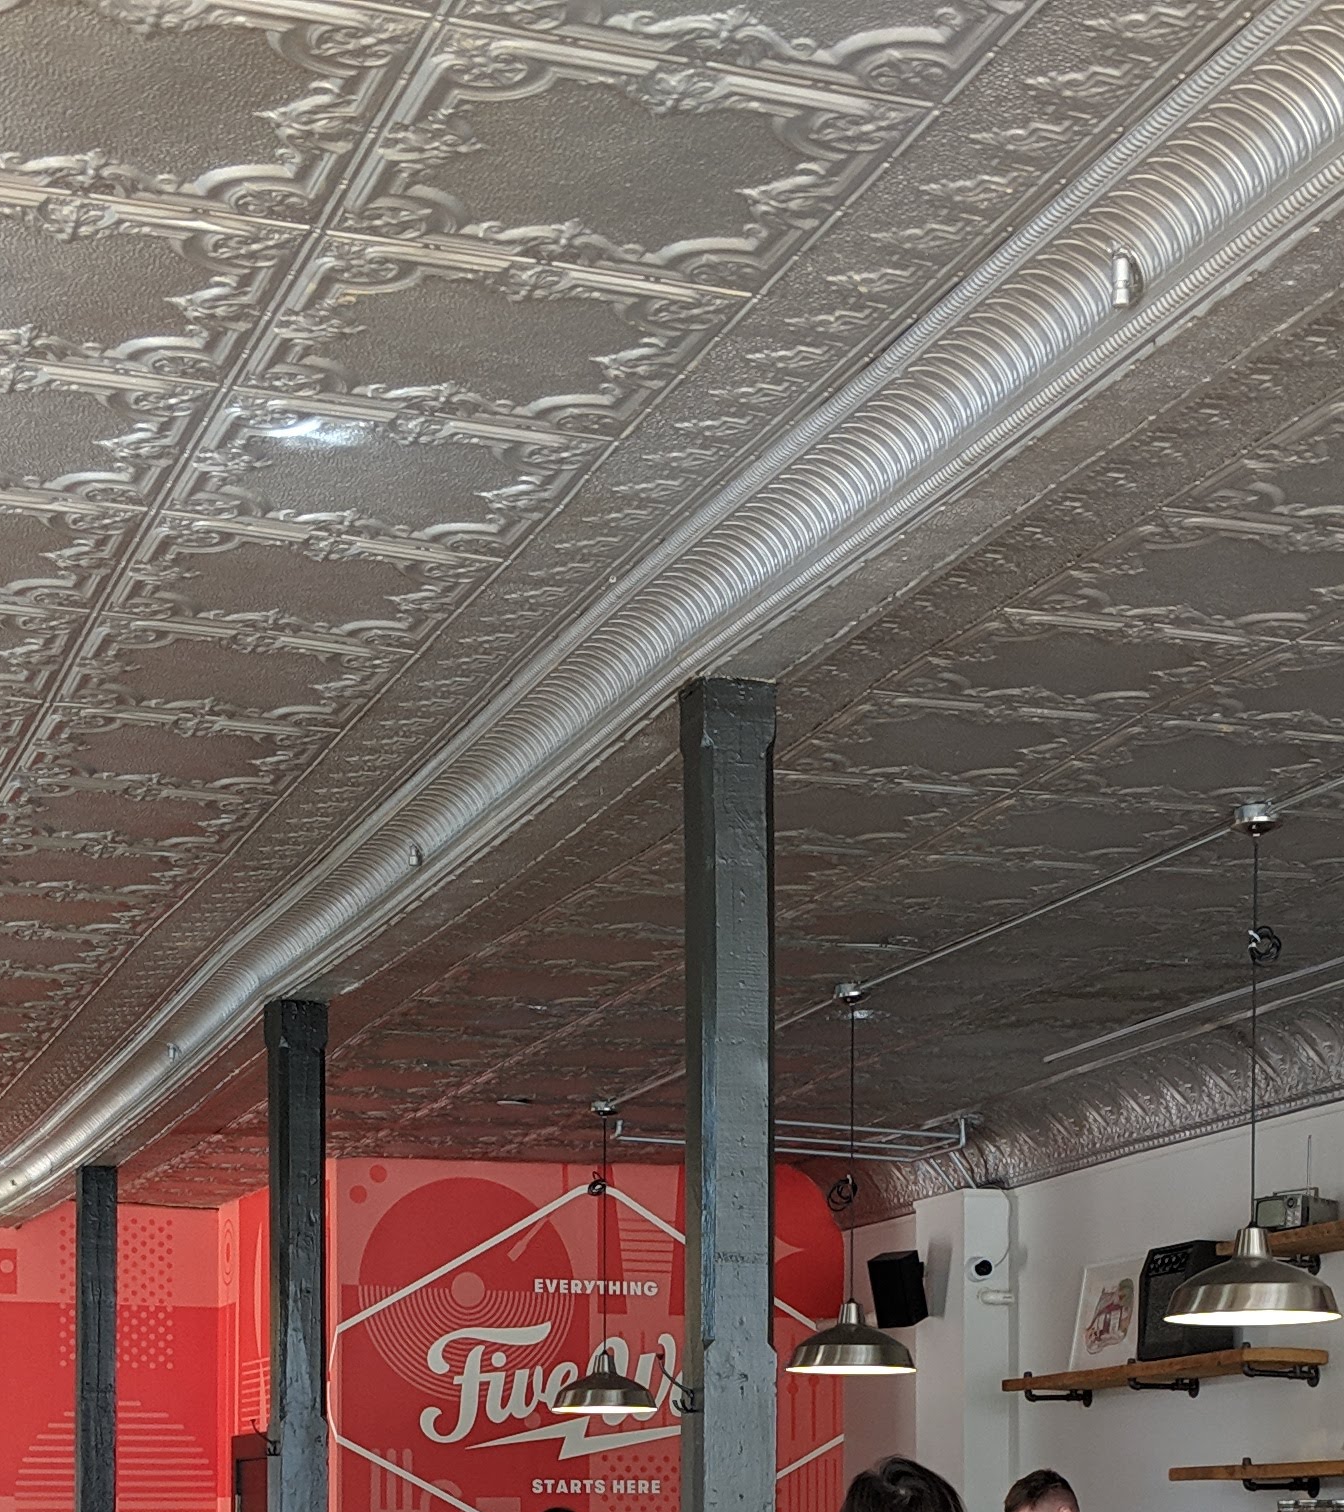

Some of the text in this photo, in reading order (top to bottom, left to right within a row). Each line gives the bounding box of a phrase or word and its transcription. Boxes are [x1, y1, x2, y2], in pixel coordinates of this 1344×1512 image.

[534, 1278, 658, 1296] EVERYTHING
[419, 1320, 579, 1443] Five
[532, 1478, 661, 1494] STARTS HERE
